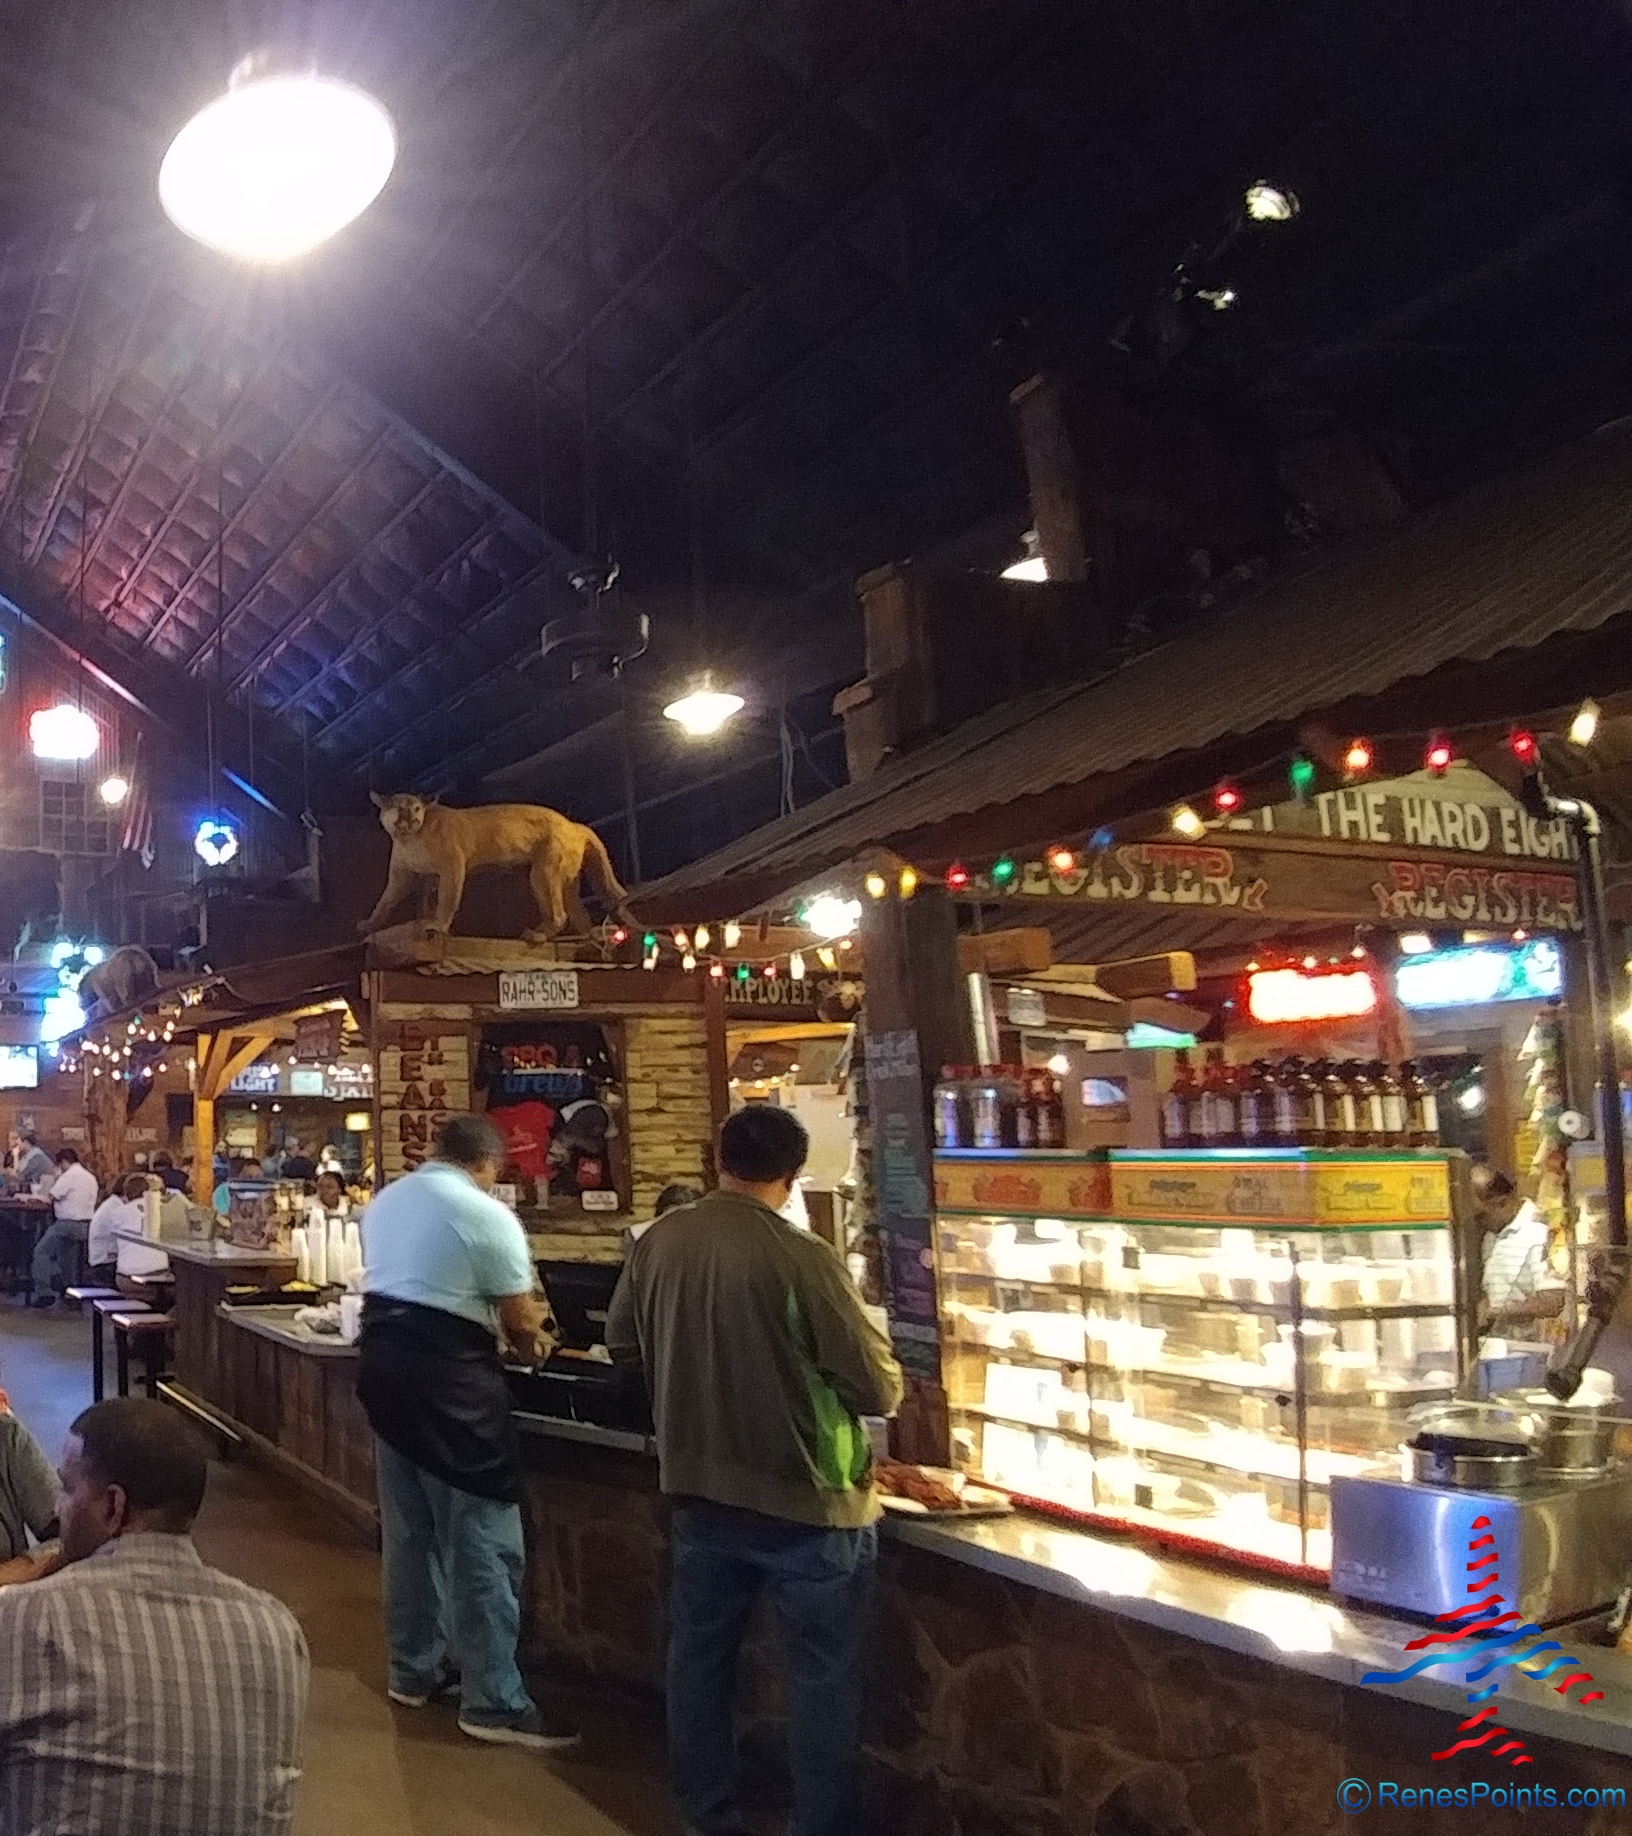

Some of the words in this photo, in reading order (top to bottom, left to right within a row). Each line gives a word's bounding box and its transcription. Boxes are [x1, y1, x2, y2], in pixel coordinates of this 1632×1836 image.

[1316, 790, 1392, 843] THE
[1402, 796, 1490, 852] HARD
[975, 844, 1241, 906] EGISTER
[1388, 861, 1583, 931] REGISTER
[502, 979, 576, 1003] RAHR-SONS
[724, 976, 814, 1005] MPLOYEE
